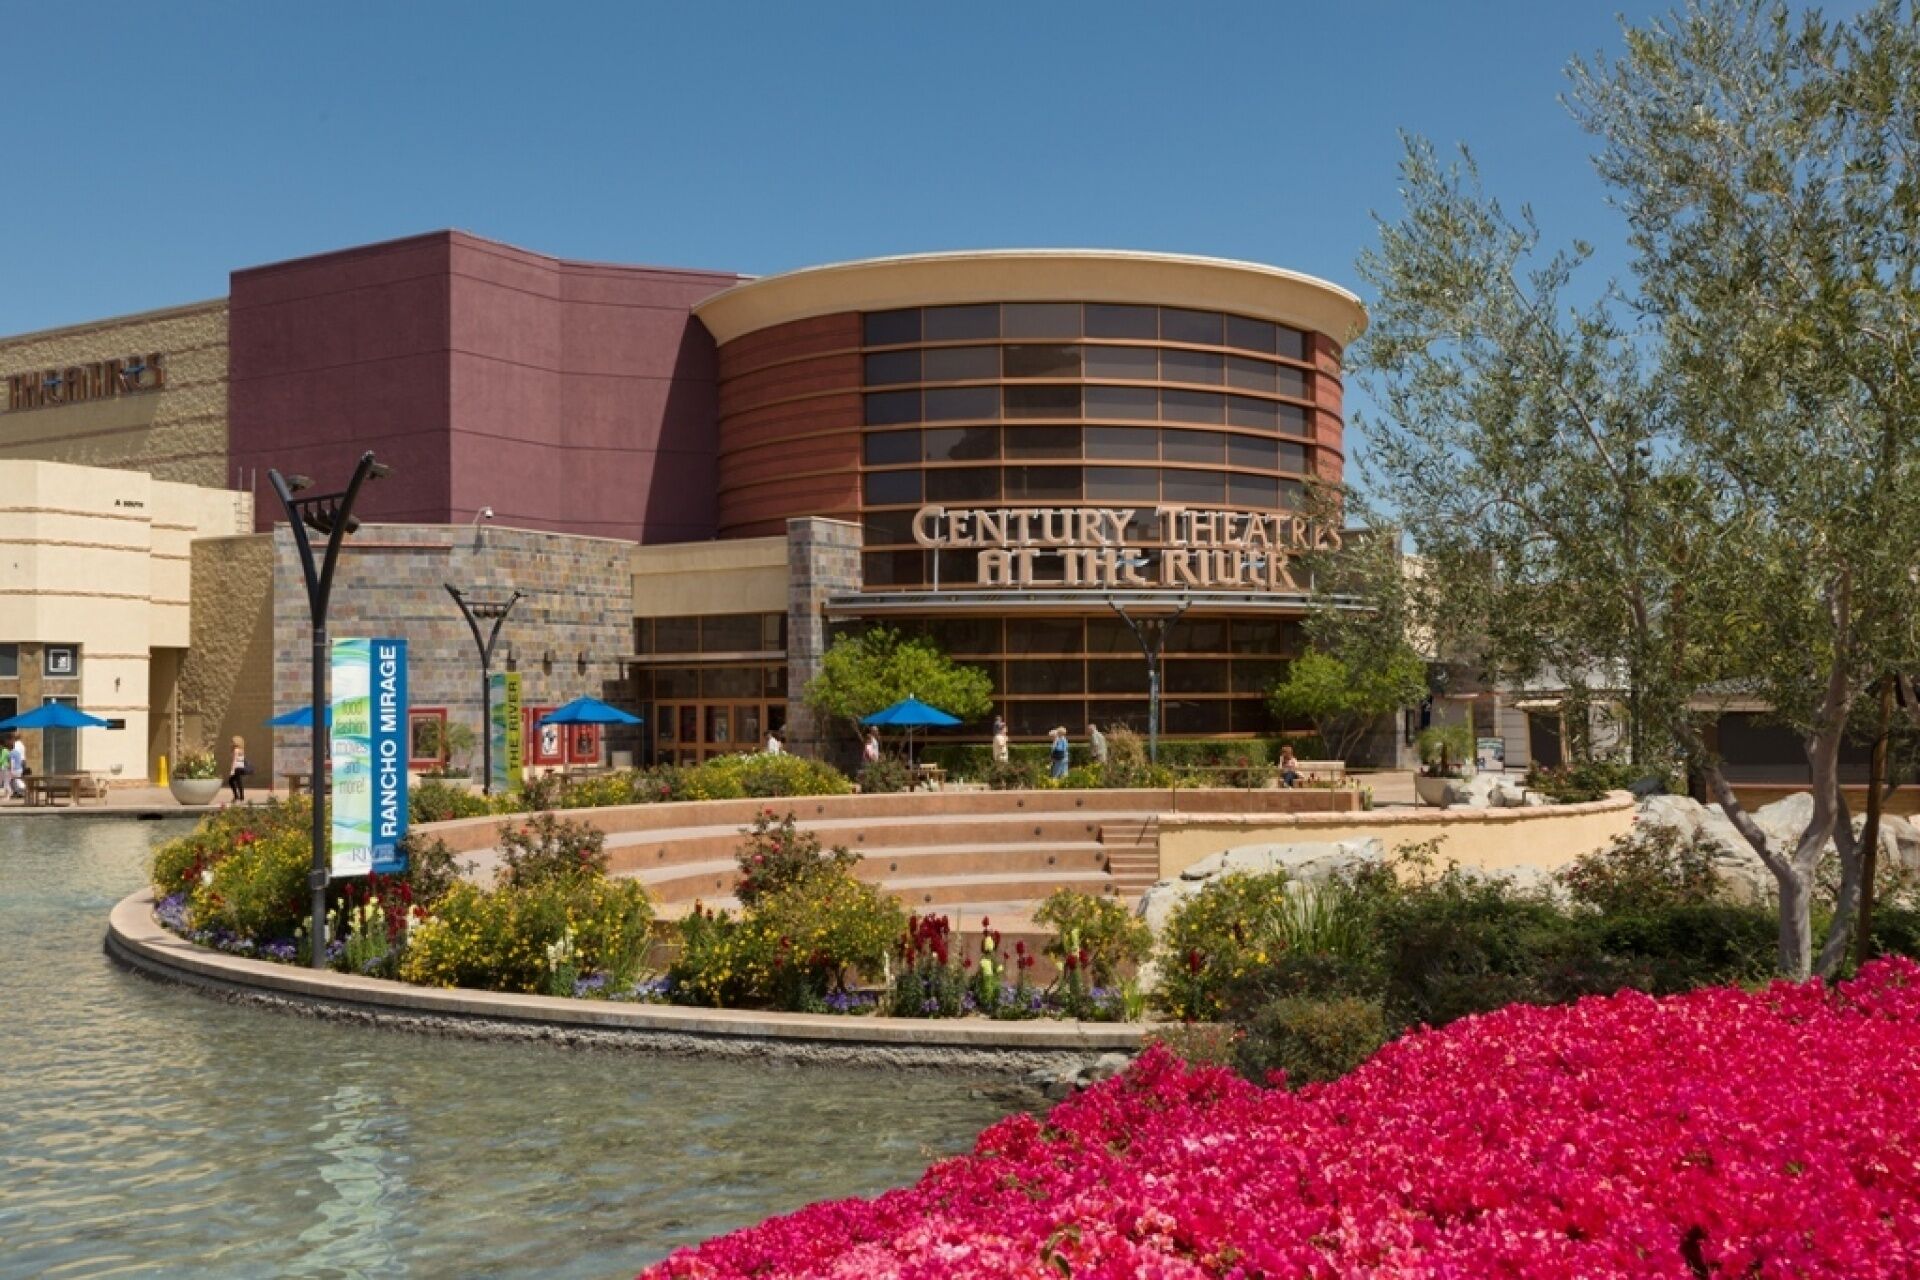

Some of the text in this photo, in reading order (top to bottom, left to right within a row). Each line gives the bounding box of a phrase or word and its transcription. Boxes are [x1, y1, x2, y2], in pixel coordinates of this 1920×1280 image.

[912, 505, 1342, 550] CENTURY THEATRES
[978, 548, 1298, 589] AT THE RIVER
[380, 645, 396, 837] RANCHO MIRAGE
[508, 681, 518, 770] THE RIVER
